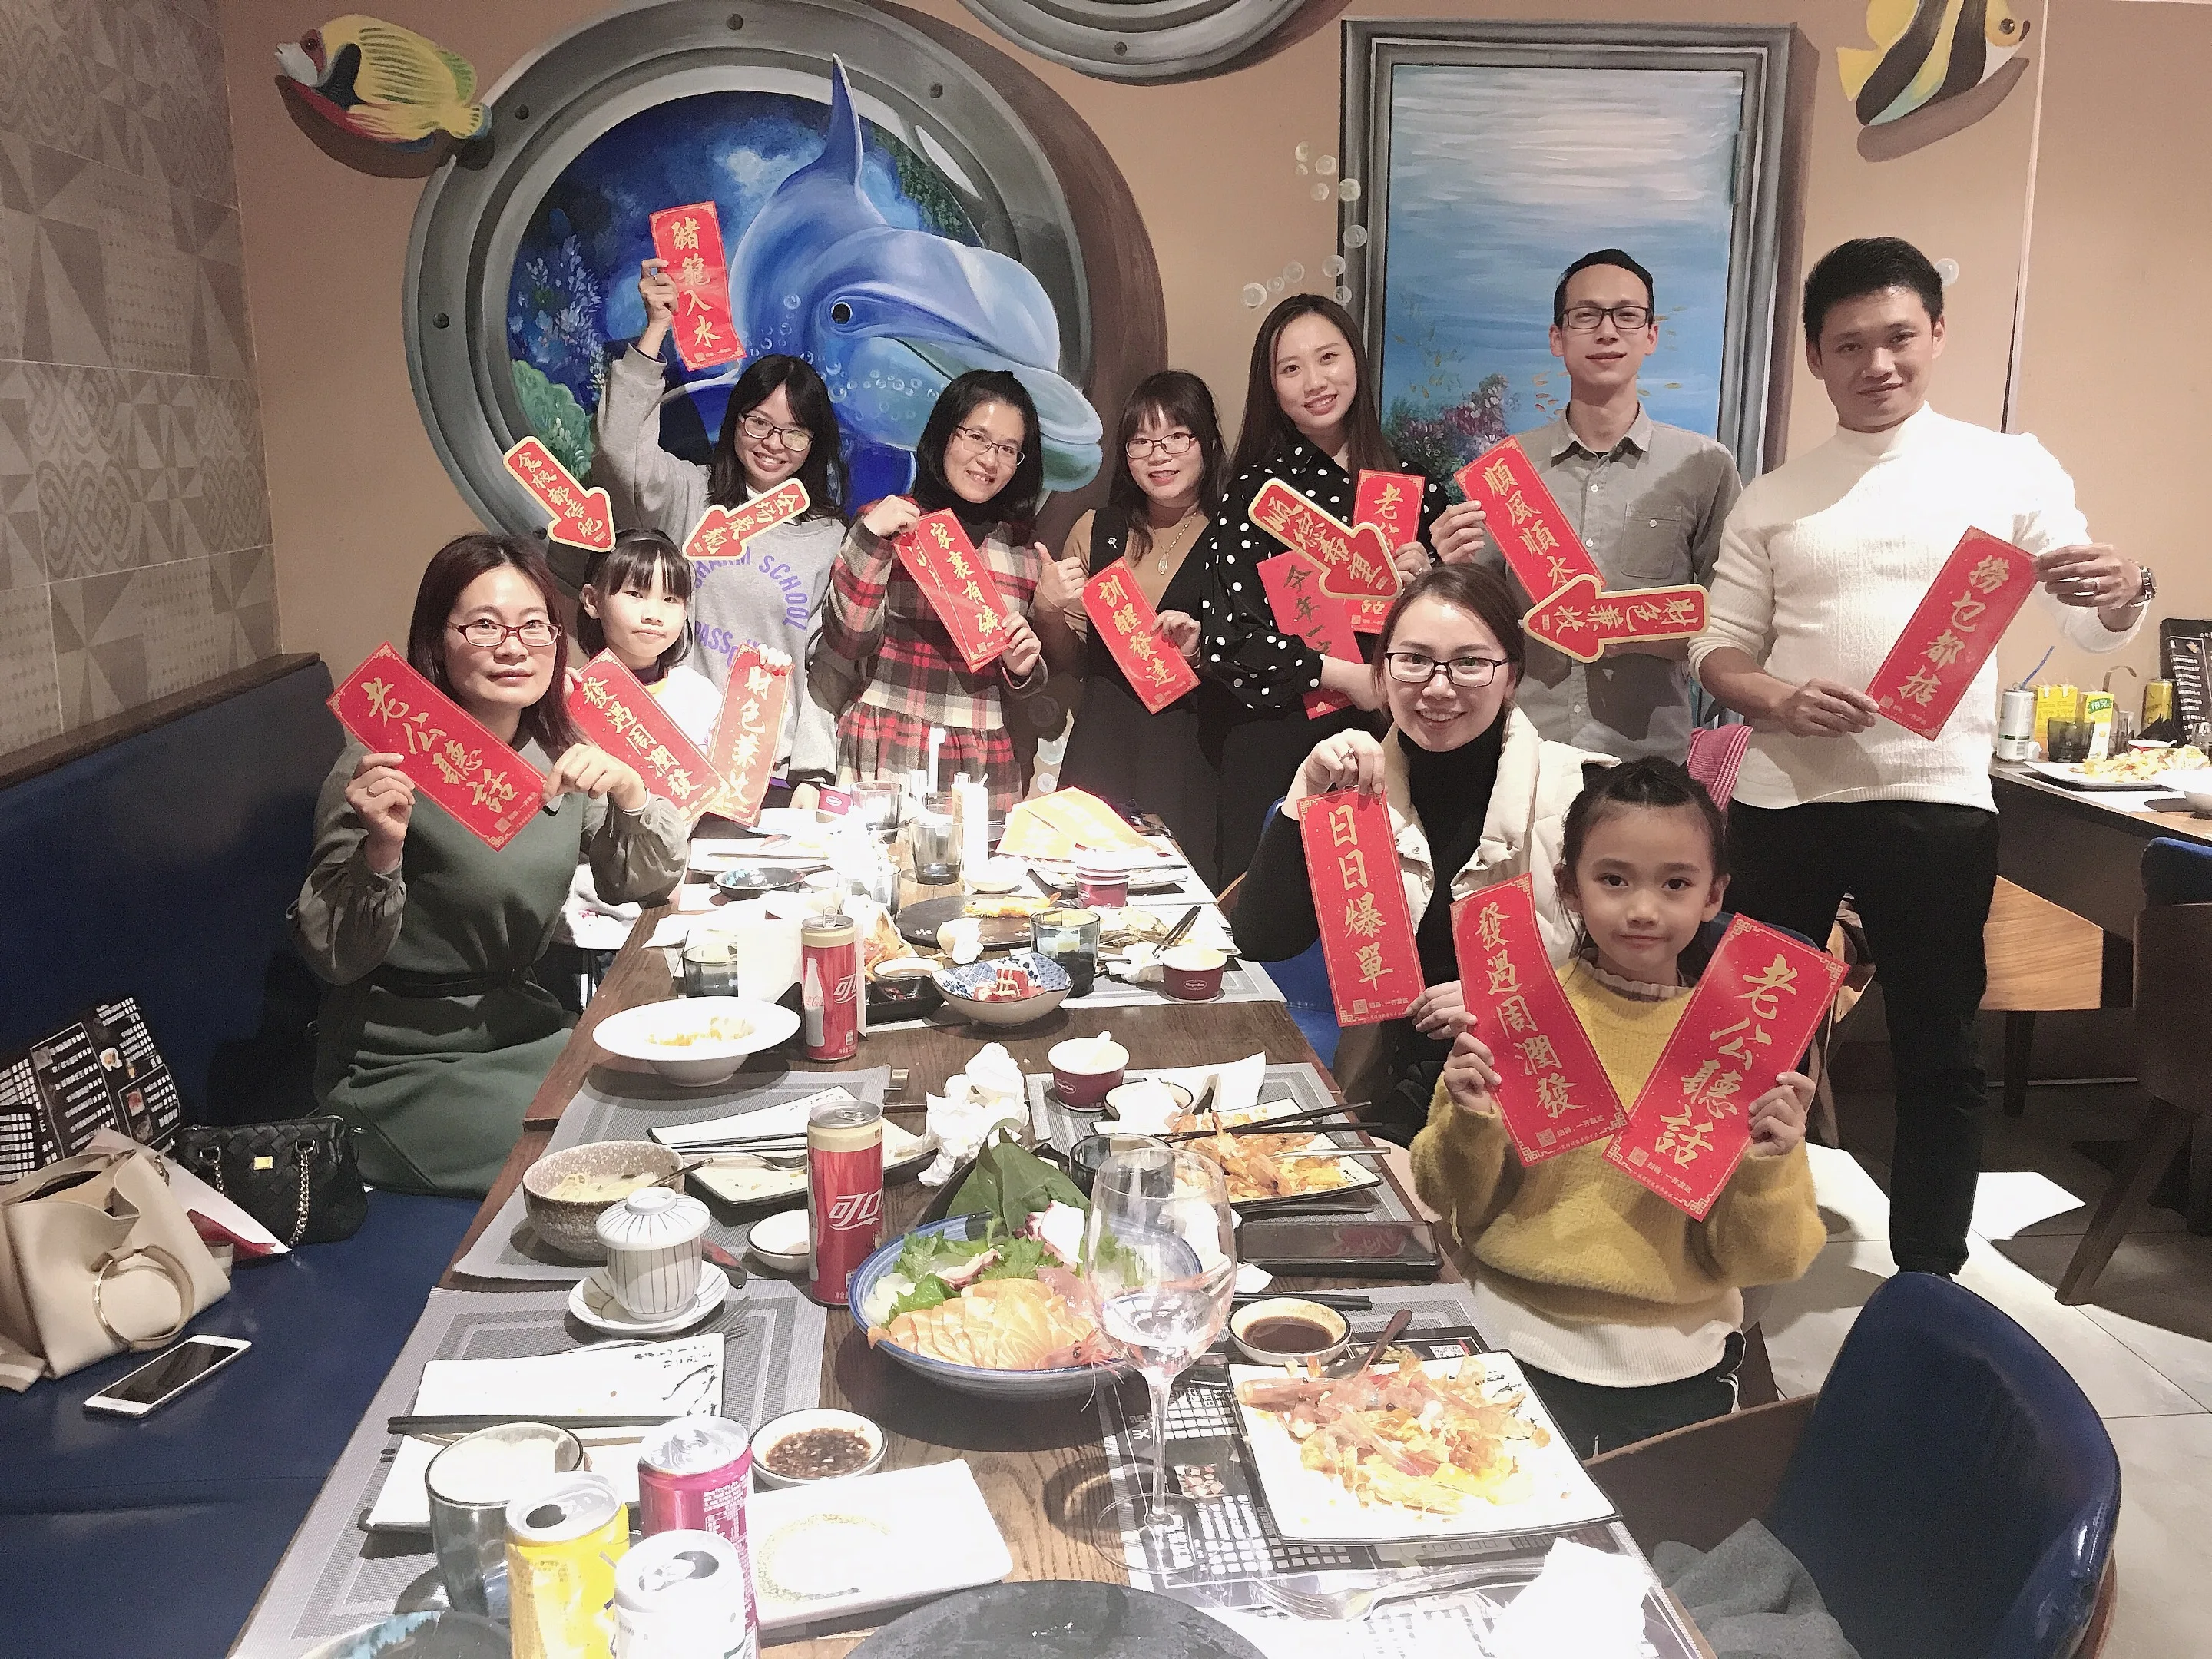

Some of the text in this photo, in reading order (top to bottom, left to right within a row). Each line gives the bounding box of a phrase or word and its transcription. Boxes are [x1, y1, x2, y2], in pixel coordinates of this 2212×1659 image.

[671, 217, 723, 348] 豬籠入水
[1482, 458, 1578, 588] 順風順水
[759, 555, 809, 630] SCHOOL
[361, 677, 518, 813] 老公聽話
[1329, 804, 1393, 992] 日日爆單
[1474, 901, 1586, 1119] 發過周潤發
[1654, 954, 1798, 1170] 老公聽話
